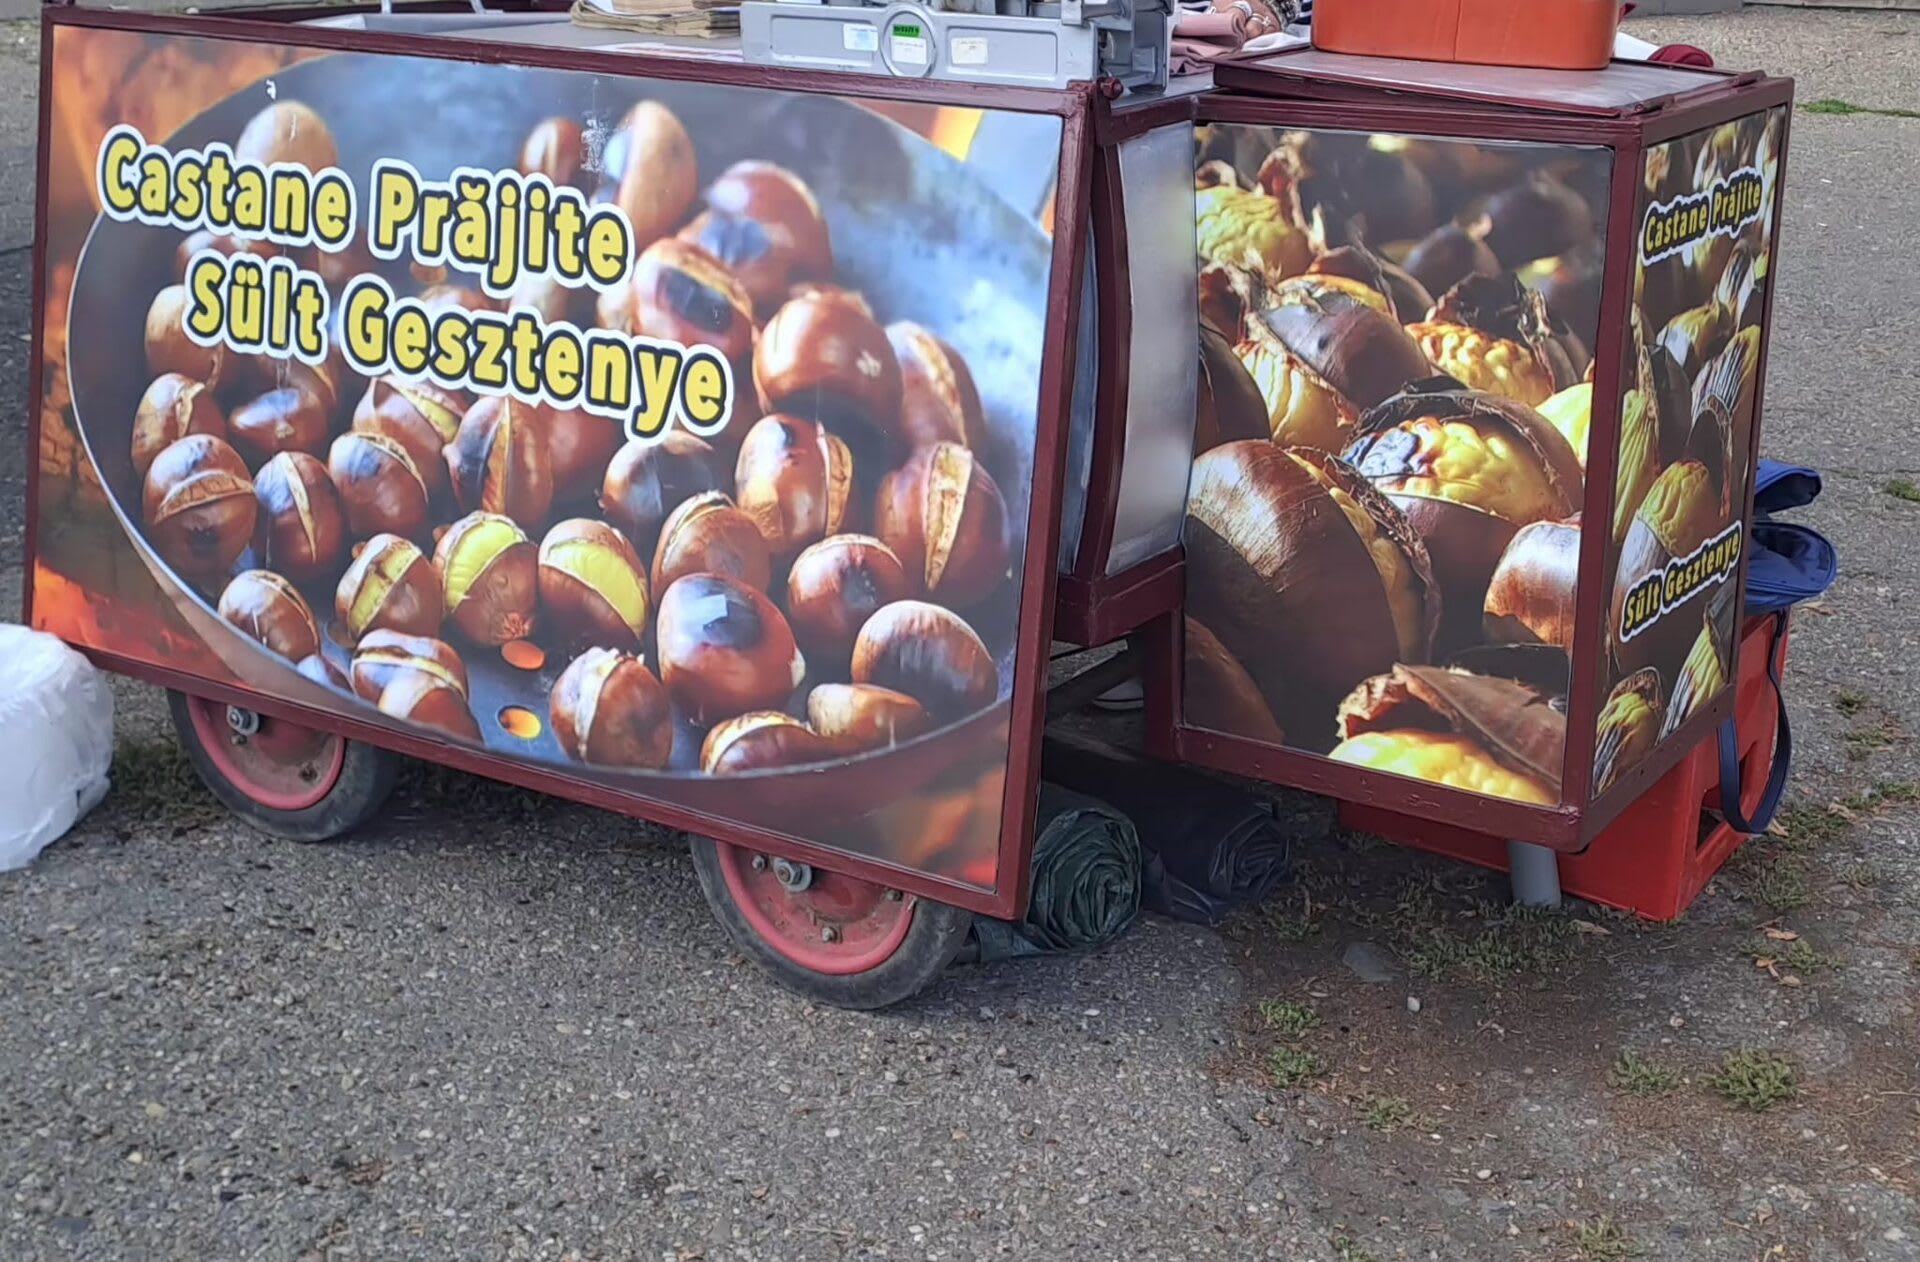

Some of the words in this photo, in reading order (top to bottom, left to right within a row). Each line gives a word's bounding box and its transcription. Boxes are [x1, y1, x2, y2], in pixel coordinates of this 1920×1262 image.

[102, 131, 351, 245] Castane
[376, 167, 628, 288] Prăjite
[1644, 199, 1709, 255] Castane
[1711, 178, 1763, 228] Prăjite
[189, 258, 324, 355] Sült
[344, 287, 727, 436] Gesztenye
[1624, 579, 1661, 632] Sült
[1664, 530, 1740, 603] Gesztenye
